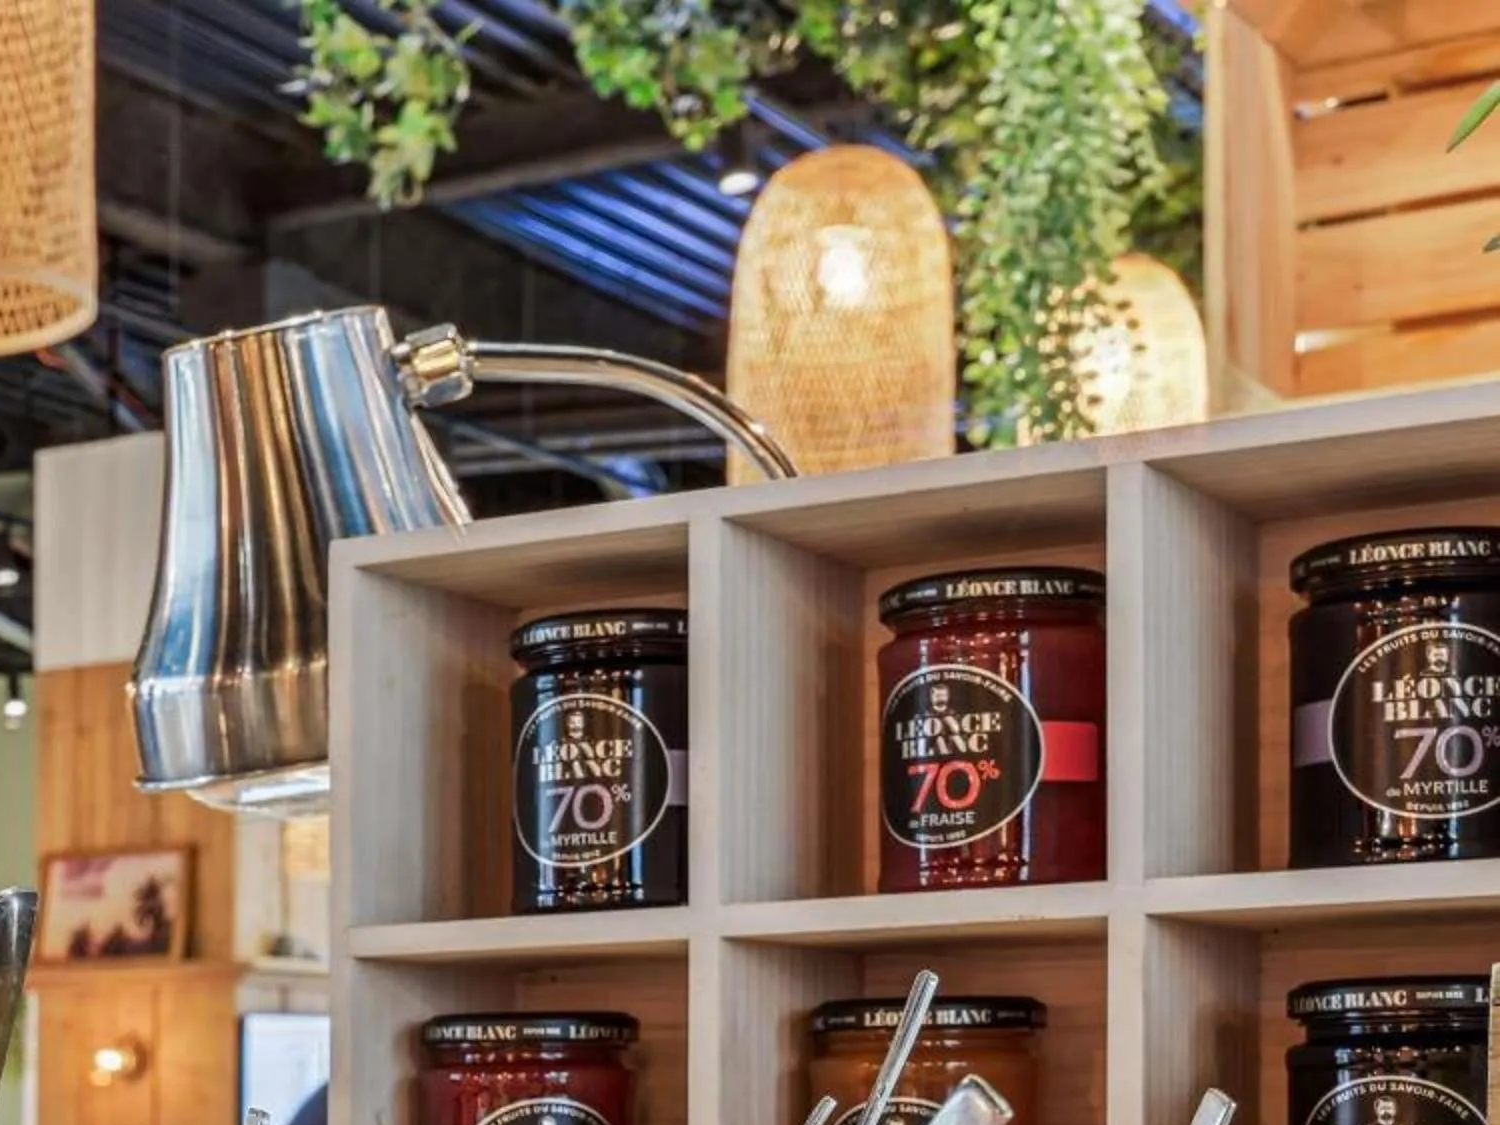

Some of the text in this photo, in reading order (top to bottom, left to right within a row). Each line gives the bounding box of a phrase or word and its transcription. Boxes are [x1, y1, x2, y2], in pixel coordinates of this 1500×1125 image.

[1349, 543, 1425, 565] LÉONCE
[1429, 541, 1491, 558] BLANC
[946, 578, 1017, 599] LÉONCE
[1019, 577, 1074, 596] BLANC
[573, 621, 627, 639] BLANC
[1384, 697, 1491, 722] BLANC
[896, 711, 1001, 741] LÉONCE
[533, 739, 633, 765] LÉONCE
[901, 733, 988, 759] BLANC
[539, 758, 622, 782] BLANC
[1403, 779, 1489, 797] MYRTILLE
[921, 811, 976, 827] FRAISE
[551, 831, 617, 846] MYRTILLE
[1344, 990, 1407, 1009] BLANC
[864, 1008, 932, 1027] LÉOE
[935, 1008, 992, 1025] BLANC
[466, 1025, 517, 1041] BLANC
[1390, 1082, 1470, 1120] SAVOIR-FAIRE
